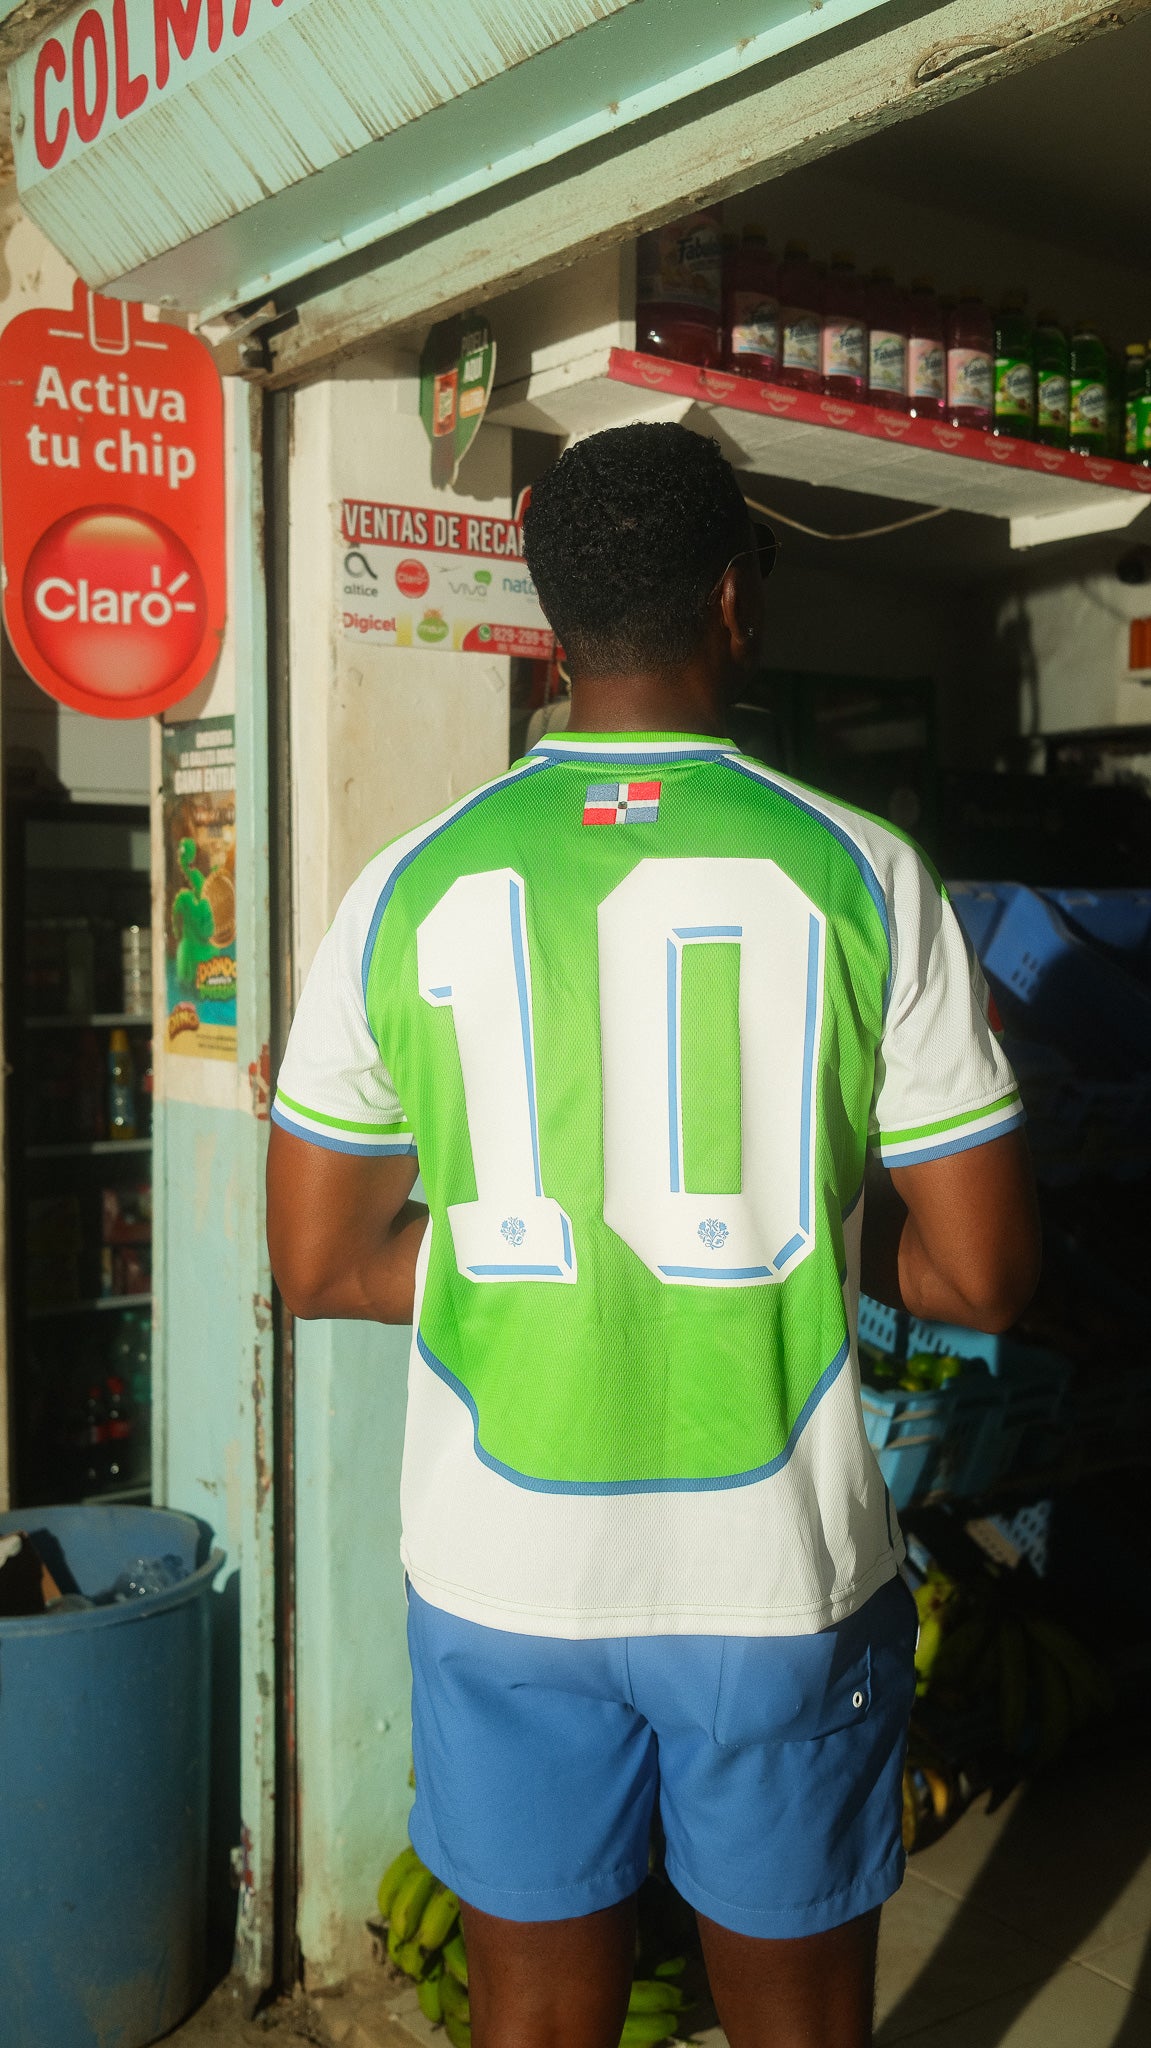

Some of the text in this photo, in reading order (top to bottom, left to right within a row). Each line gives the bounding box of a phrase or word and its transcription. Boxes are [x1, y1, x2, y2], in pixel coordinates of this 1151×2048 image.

[36, 366, 187, 423] Activa
[27, 425, 197, 489] tu chip
[344, 503, 428, 544] VENTAS
[434, 515, 460, 549] DE
[35, 577, 173, 626] Claro
[344, 582, 378, 597] altice
[343, 612, 397, 634] Digicel
[416, 857, 827, 1286] 10
